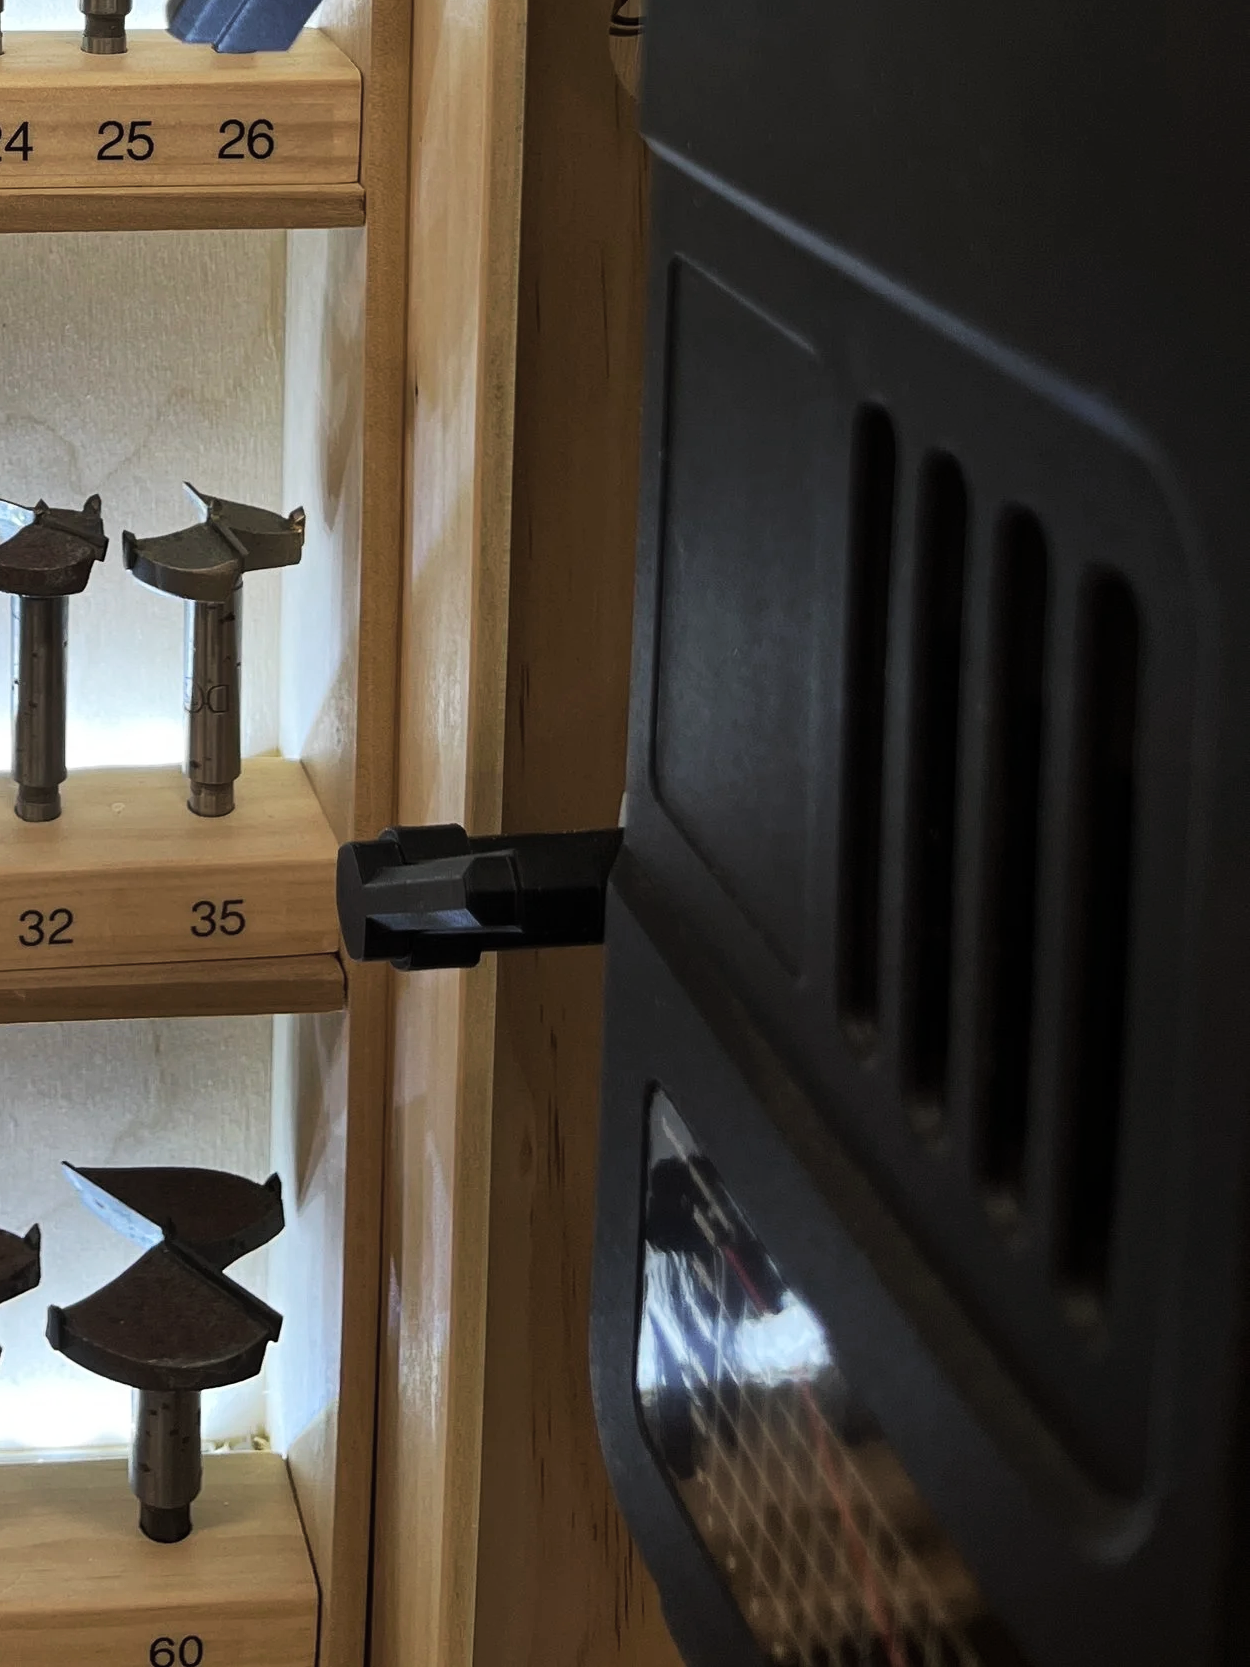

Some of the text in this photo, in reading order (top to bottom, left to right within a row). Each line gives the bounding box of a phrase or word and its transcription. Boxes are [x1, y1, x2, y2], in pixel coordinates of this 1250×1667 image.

[97, 121, 155, 162] 25
[218, 119, 275, 160] 26
[19, 908, 74, 947] 32
[191, 900, 246, 938] 35
[150, 1635, 204, 1667] 60
